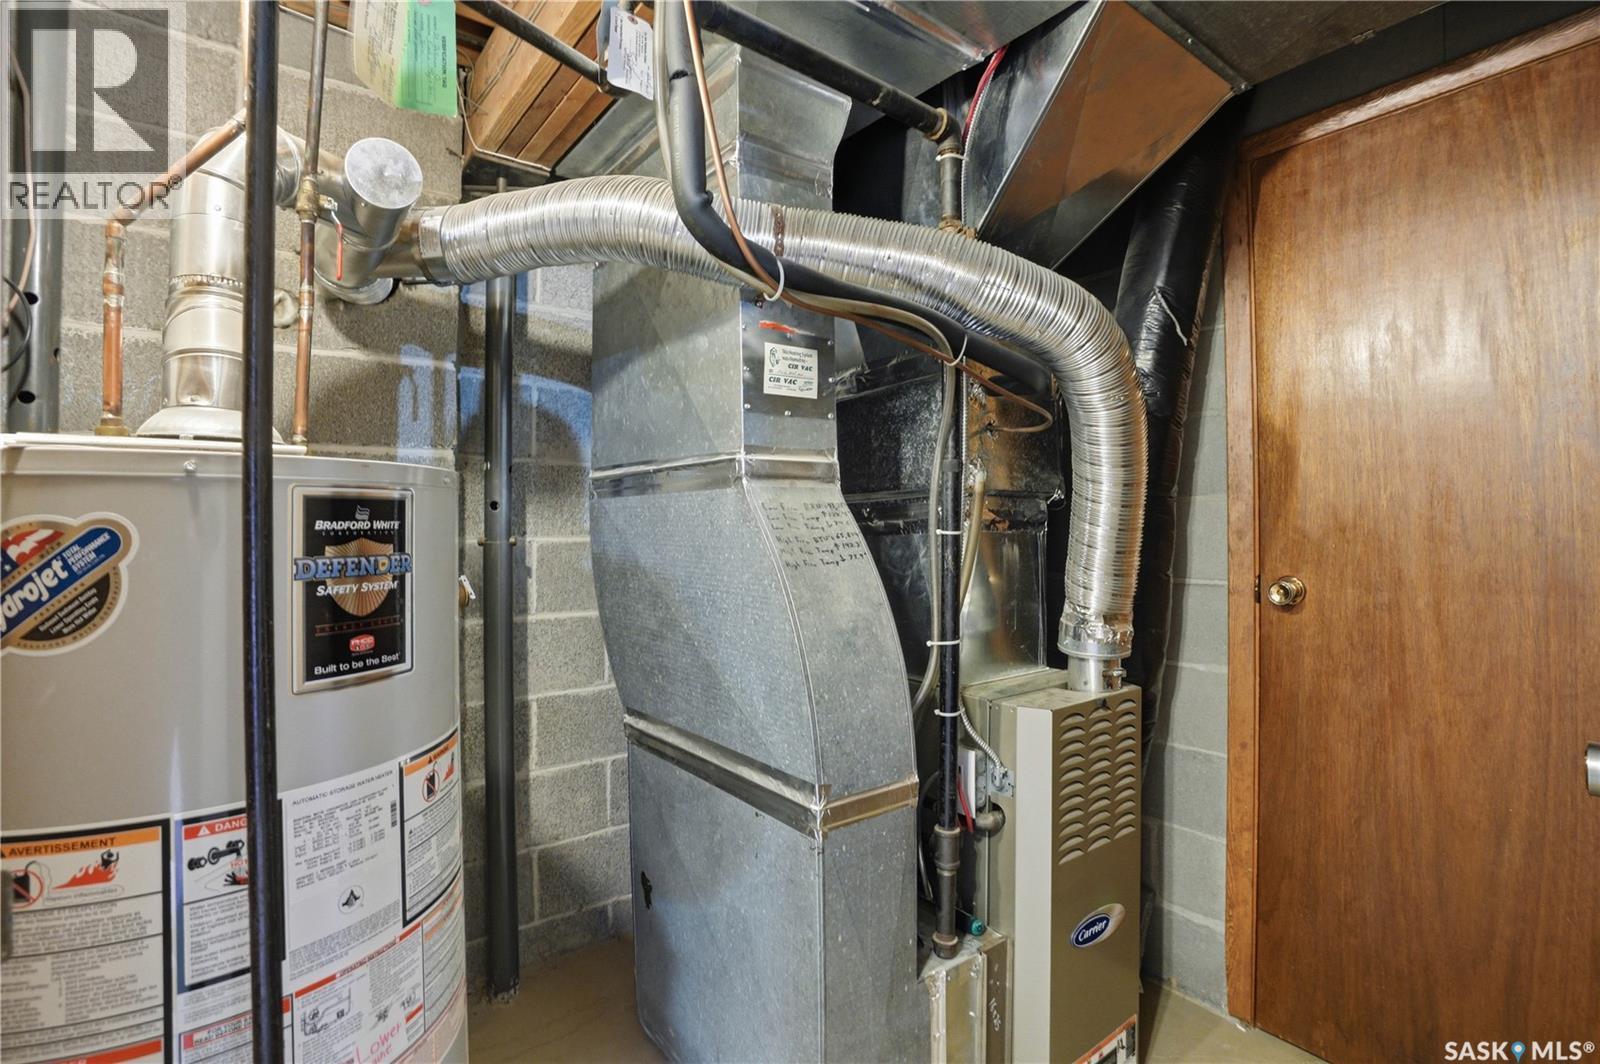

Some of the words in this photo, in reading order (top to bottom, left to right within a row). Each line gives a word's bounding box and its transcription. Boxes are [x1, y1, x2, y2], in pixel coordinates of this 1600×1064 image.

[314, 520, 371, 530] BRADFORD
[373, 520, 400, 529] WHITE
[62, 544, 82, 559] TOTAL
[68, 532, 111, 566] PERFORMANCE
[72, 552, 98, 572] SYSTEM
[294, 554, 413, 580] DEFENDER
[316, 584, 359, 597] SAFETY
[361, 580, 399, 592] SYSTEM
[314, 664, 338, 676] Built
[340, 662, 350, 672] to
[352, 660, 364, 670] be
[366, 656, 380, 666] the
[382, 653, 400, 663] Best
[292, 792, 328, 806] AUTOMATIC
[329, 784, 356, 796] STORAGE
[357, 776, 375, 786] WATER
[8, 836, 117, 856] AVERTISSEMENT
[1078, 918, 1108, 942] Carrier
